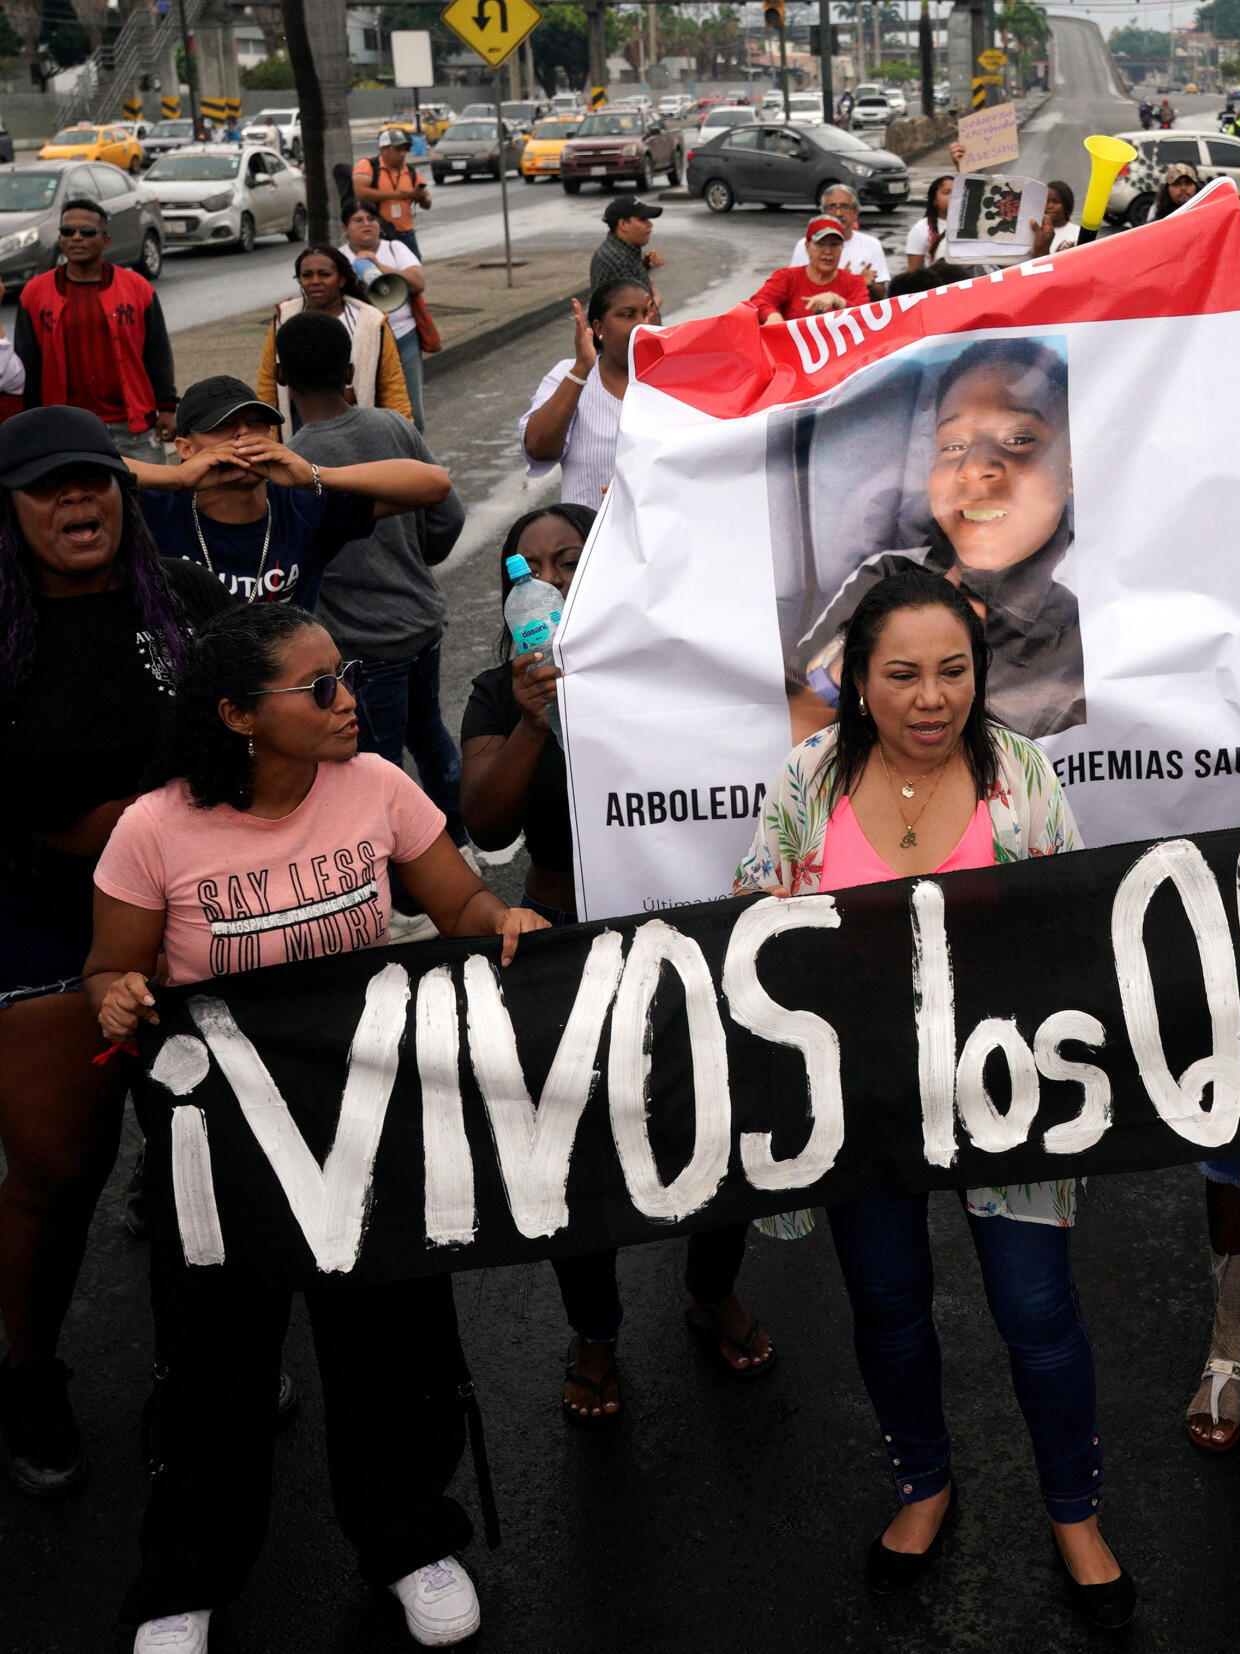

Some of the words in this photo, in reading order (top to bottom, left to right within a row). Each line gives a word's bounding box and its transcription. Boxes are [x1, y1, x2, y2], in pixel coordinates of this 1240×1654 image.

[183, 555, 300, 599] UTICA
[1053, 749, 1184, 788] EHEMIAS
[606, 782, 767, 828] ARBOLEDA
[198, 869, 270, 922] SAY
[289, 841, 376, 906] LESS
[150, 895, 844, 1273] ¡VIVOS
